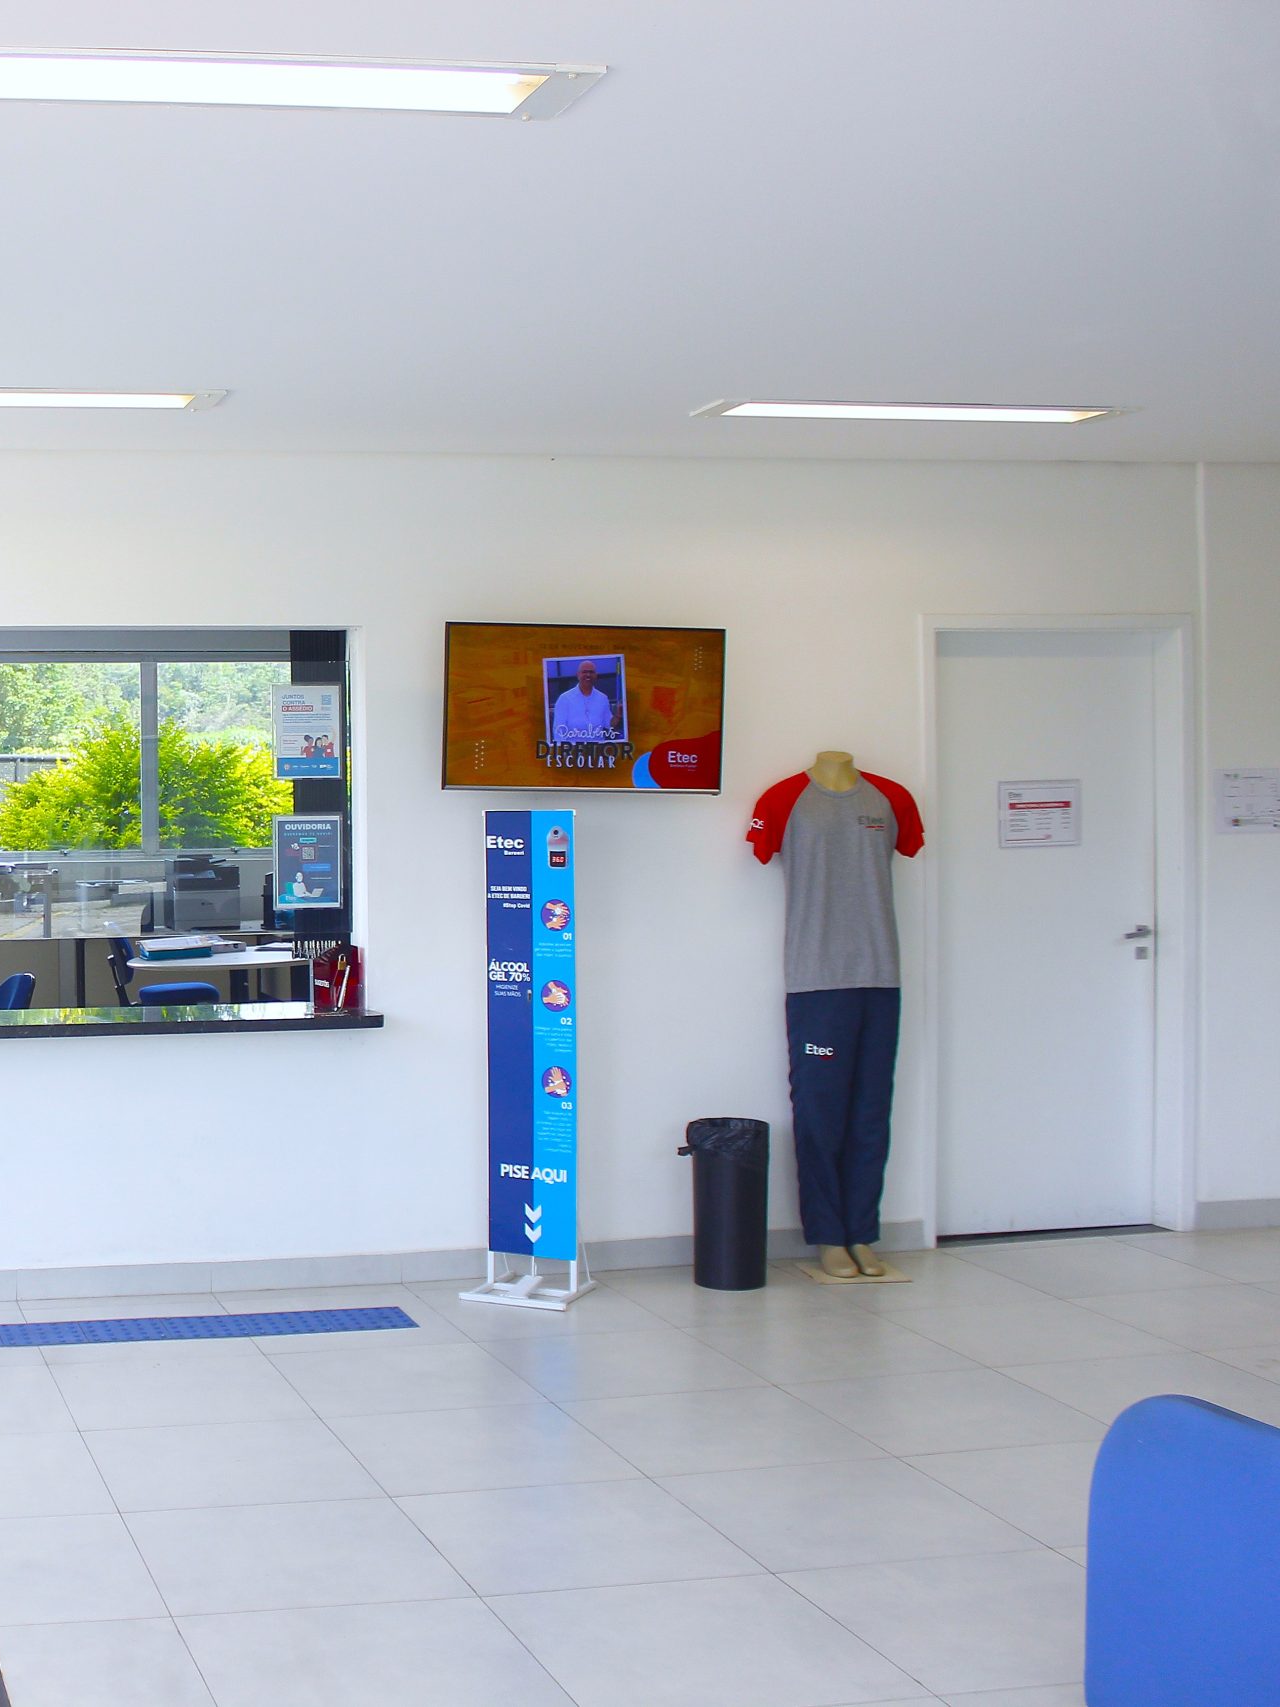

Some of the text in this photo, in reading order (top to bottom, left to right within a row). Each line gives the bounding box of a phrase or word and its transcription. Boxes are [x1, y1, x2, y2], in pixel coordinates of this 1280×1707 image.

[546, 755, 616, 768] ESCOLAR
[668, 751, 697, 763] Etec
[486, 835, 524, 849] Etec
[489, 959, 530, 972] ÁLCOOL
[489, 972, 530, 982] GEL 70%
[805, 1043, 834, 1056] Etec
[561, 1102, 572, 1110] 03
[501, 1163, 567, 1183] PISE AQUI
